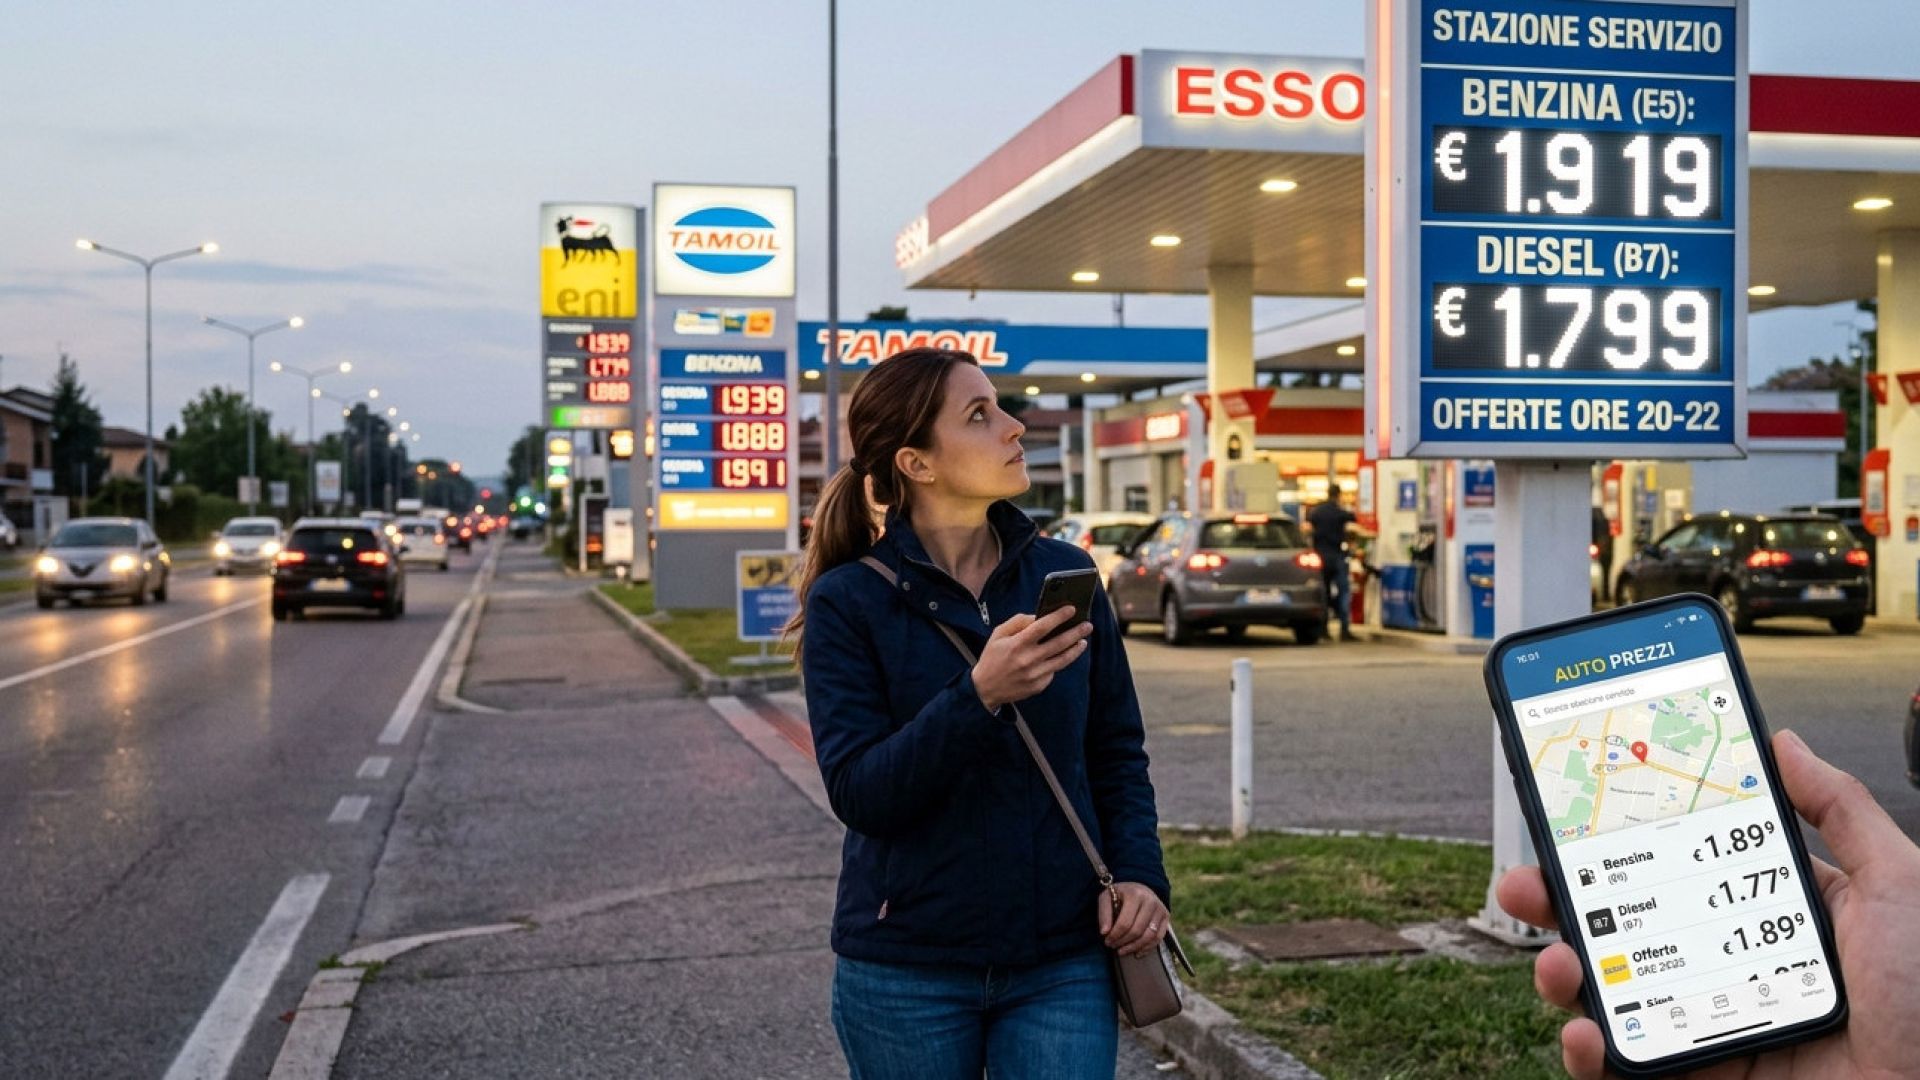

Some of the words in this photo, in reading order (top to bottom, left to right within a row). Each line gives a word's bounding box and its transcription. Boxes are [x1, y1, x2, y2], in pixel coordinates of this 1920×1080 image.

[1433, 9, 1580, 47] STAZIONE
[1588, 17, 1722, 53] SERVIZIO
[1177, 67, 1365, 121] ESSO
[1463, 78, 1623, 122] BENZINA
[1632, 87, 1696, 125] (E5):
[669, 230, 781, 250] TAMOIL
[1478, 235, 1605, 277] DIESEL
[1614, 242, 1679, 279] (B7):
[556, 277, 621, 317] eni
[1494, 286, 1710, 371] 1.799
[1433, 398, 1562, 430] OFFERTE
[1570, 399, 1629, 431] ORE
[1637, 401, 1720, 431] 20-22
[1555, 658, 1606, 684] AUTO
[1609, 642, 1675, 670] PREZZI
[1617, 896, 1657, 916] Diesel
